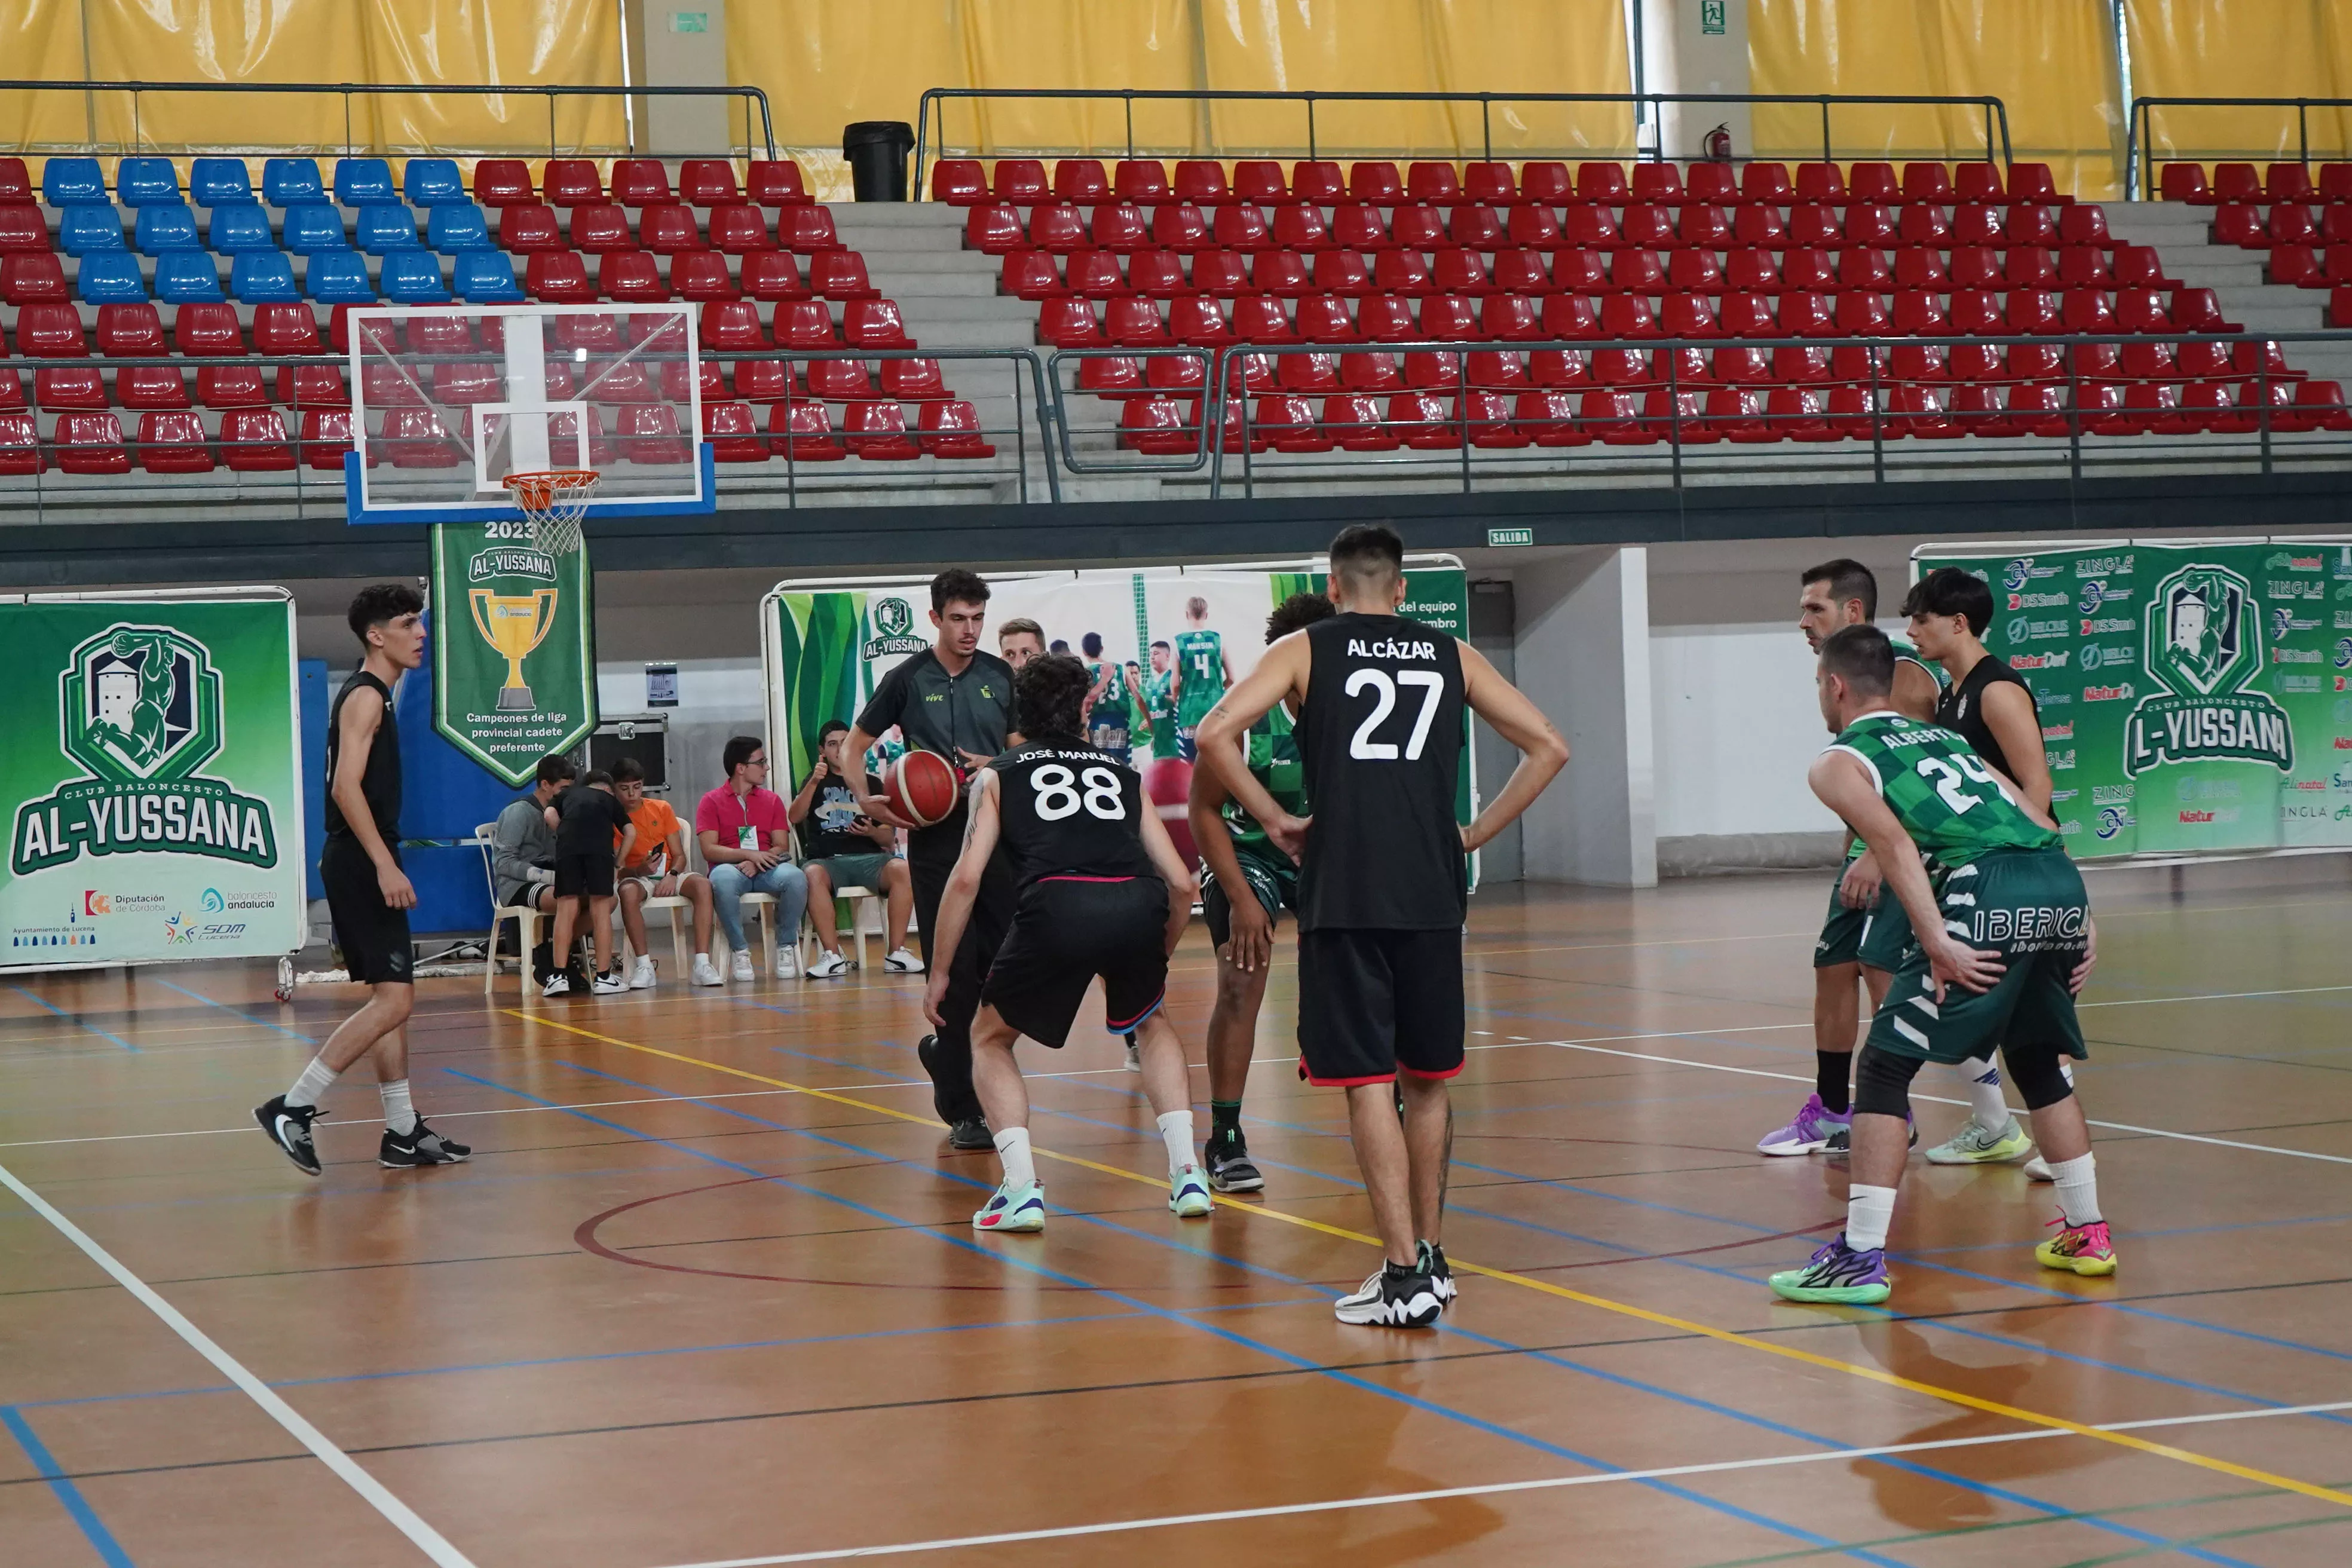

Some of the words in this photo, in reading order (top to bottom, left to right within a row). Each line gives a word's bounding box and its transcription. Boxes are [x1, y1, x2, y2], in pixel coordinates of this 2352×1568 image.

[485, 522, 537, 538] 2023
[1493, 531, 1529, 543] SALIDA
[474, 555, 552, 576] AL-YUSSANA
[1399, 601, 1416, 612] del
[1419, 601, 1457, 614] equipo
[866, 639, 927, 658] AL-YUSSANA
[1348, 637, 1436, 660] ALCÁZAR
[1195, 654, 1209, 679] 4
[926, 694, 945, 702] vive
[2147, 701, 2180, 712] CLUB
[2185, 698, 2266, 709] BALONCESTO
[467, 713, 528, 724] Campeones
[531, 713, 544, 722] de
[548, 712, 567, 723] liga
[1345, 668, 1444, 761] 27
[472, 728, 522, 739] provincial
[526, 727, 562, 737] cadete
[489, 742, 546, 754] preferente
[1016, 749, 1055, 763] JOSÉ
[1057, 751, 1120, 765] MANUEL
[65, 786, 105, 800] CLUB
[115, 783, 223, 796] BALONCESTO
[1030, 764, 1126, 821] 88
[1916, 753, 2017, 816] 24
[22, 794, 268, 862] AL-YUSSANA
[115, 895, 164, 905] Diputación
[228, 891, 277, 901] baloncesto
[202, 924, 246, 935] SDM
